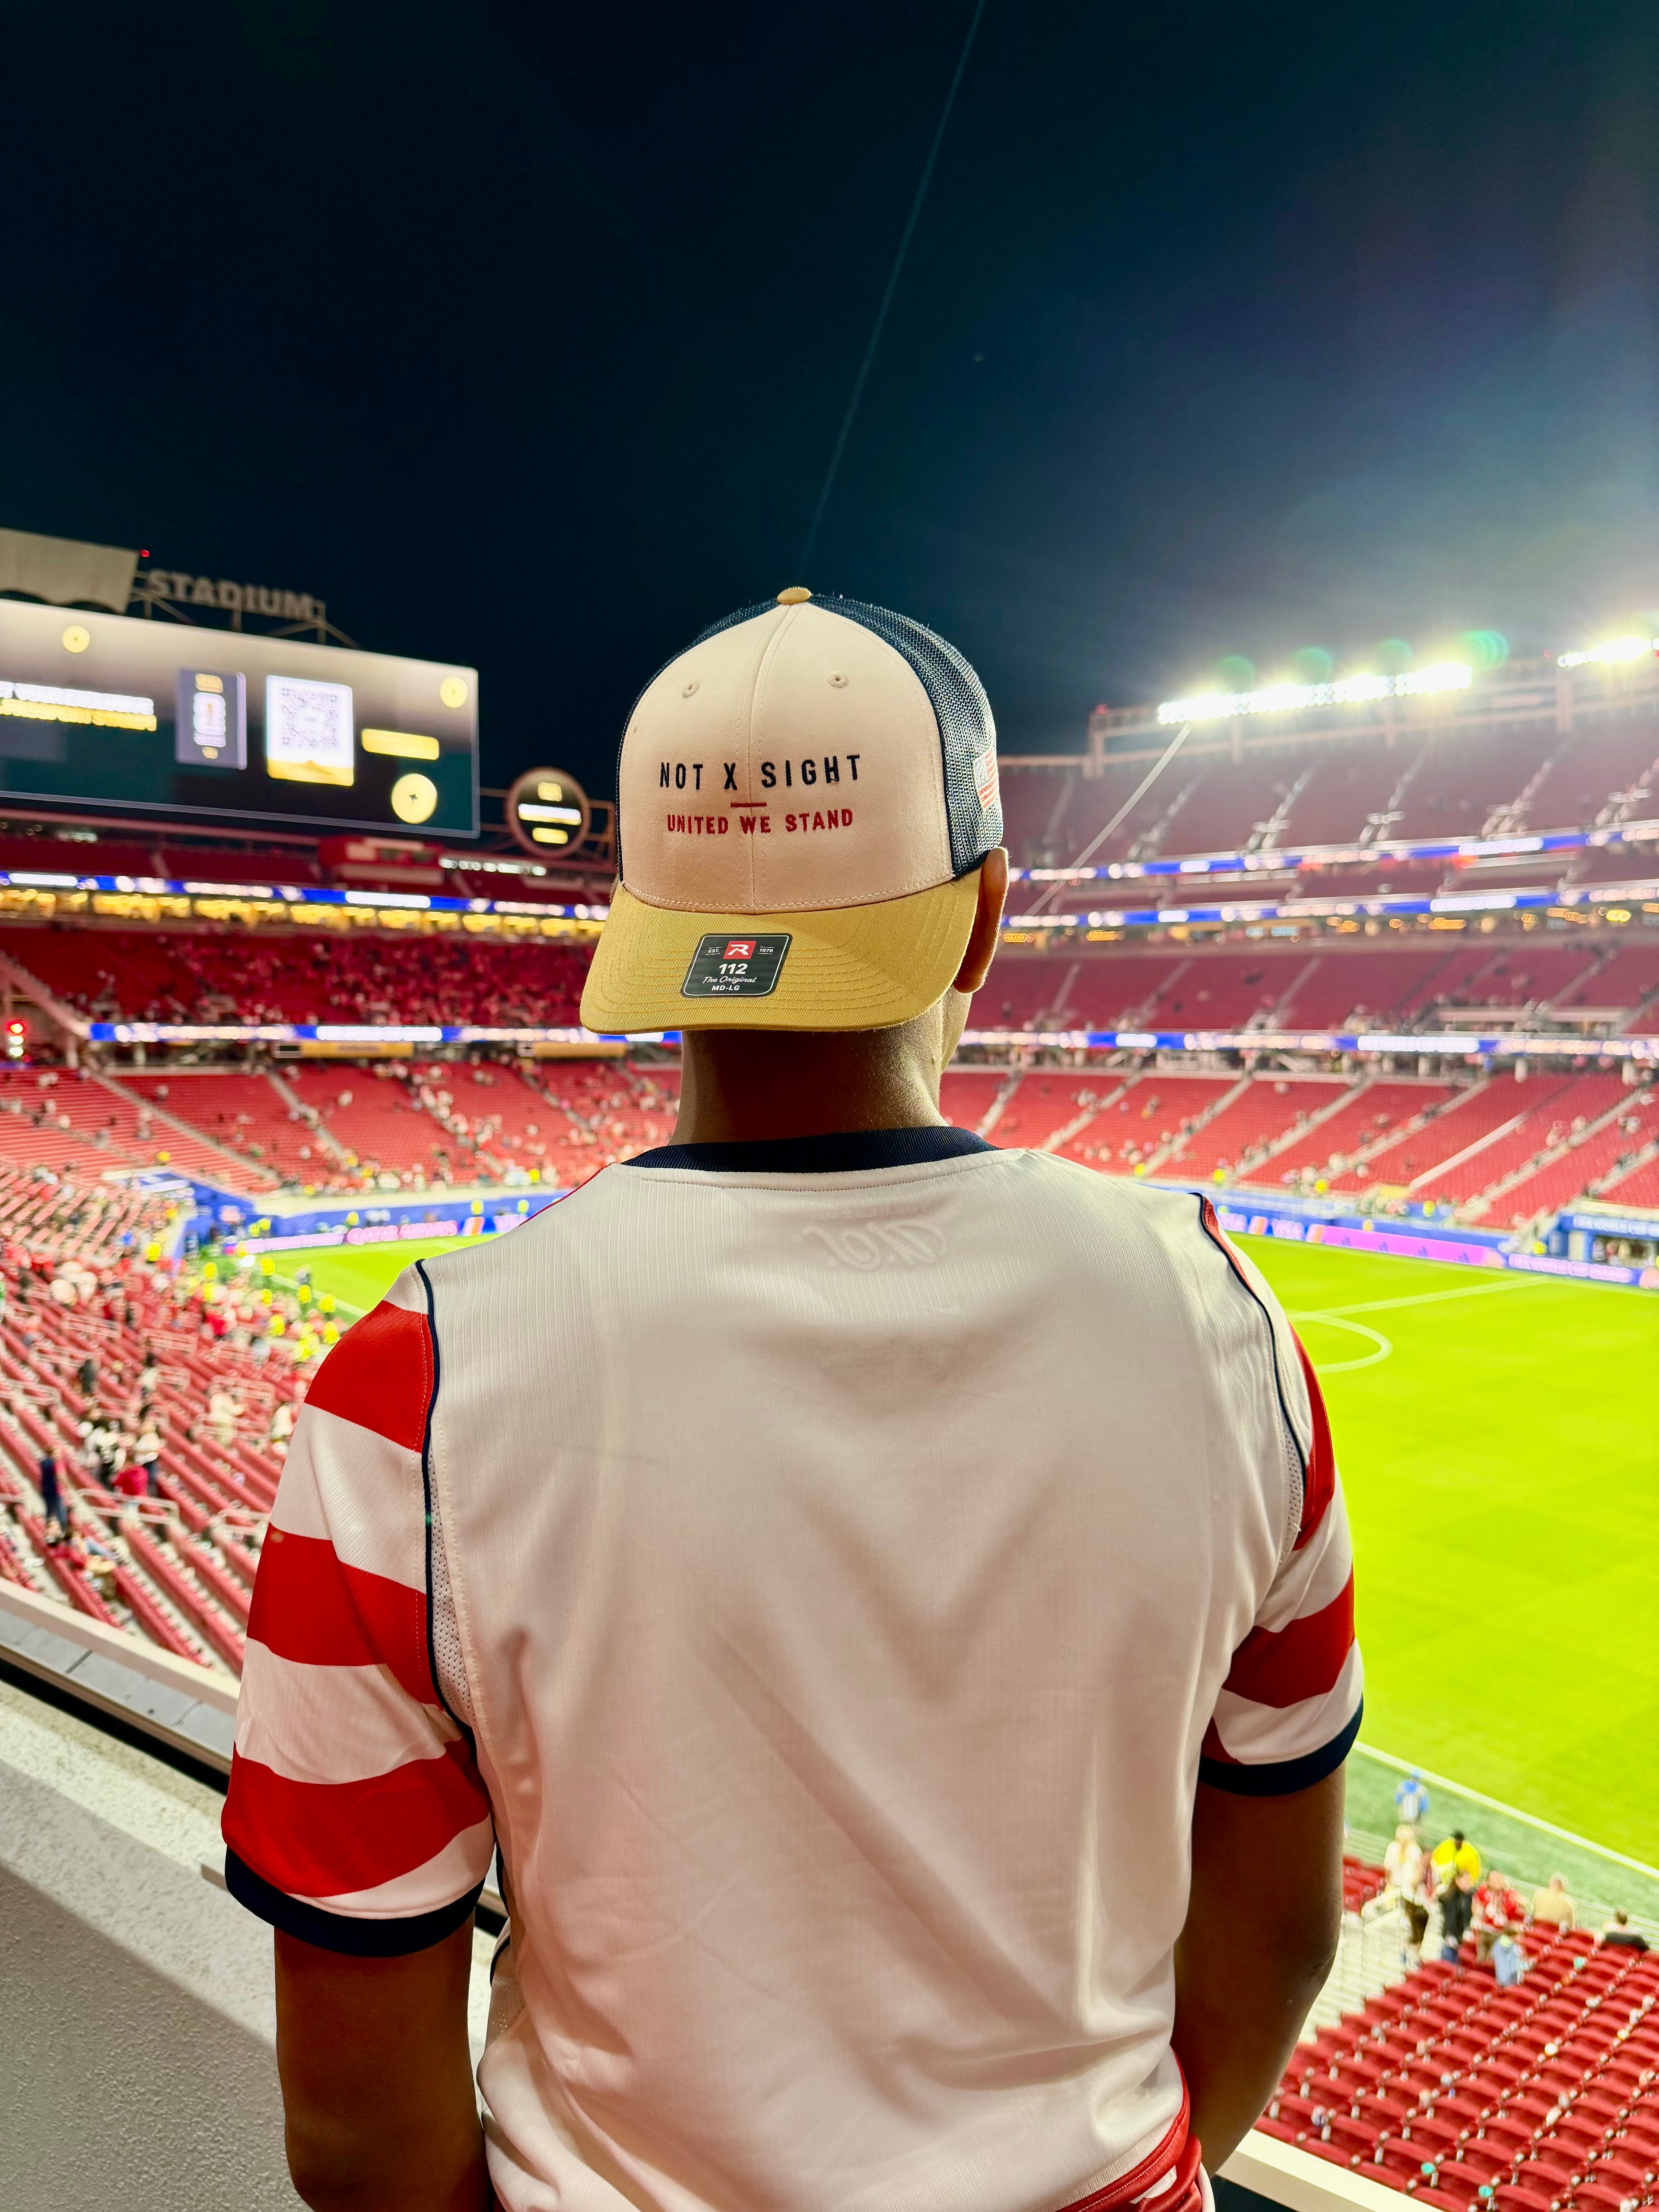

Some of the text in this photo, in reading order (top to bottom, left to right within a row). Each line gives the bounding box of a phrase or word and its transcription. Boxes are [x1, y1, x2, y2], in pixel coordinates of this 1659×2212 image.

[147, 568, 315, 620] STADIUM
[660, 754, 860, 790] NOT X SIGHT
[667, 809, 853, 834] UNITED WE STAND
[719, 963, 748, 974] 112
[719, 976, 757, 984] Original
